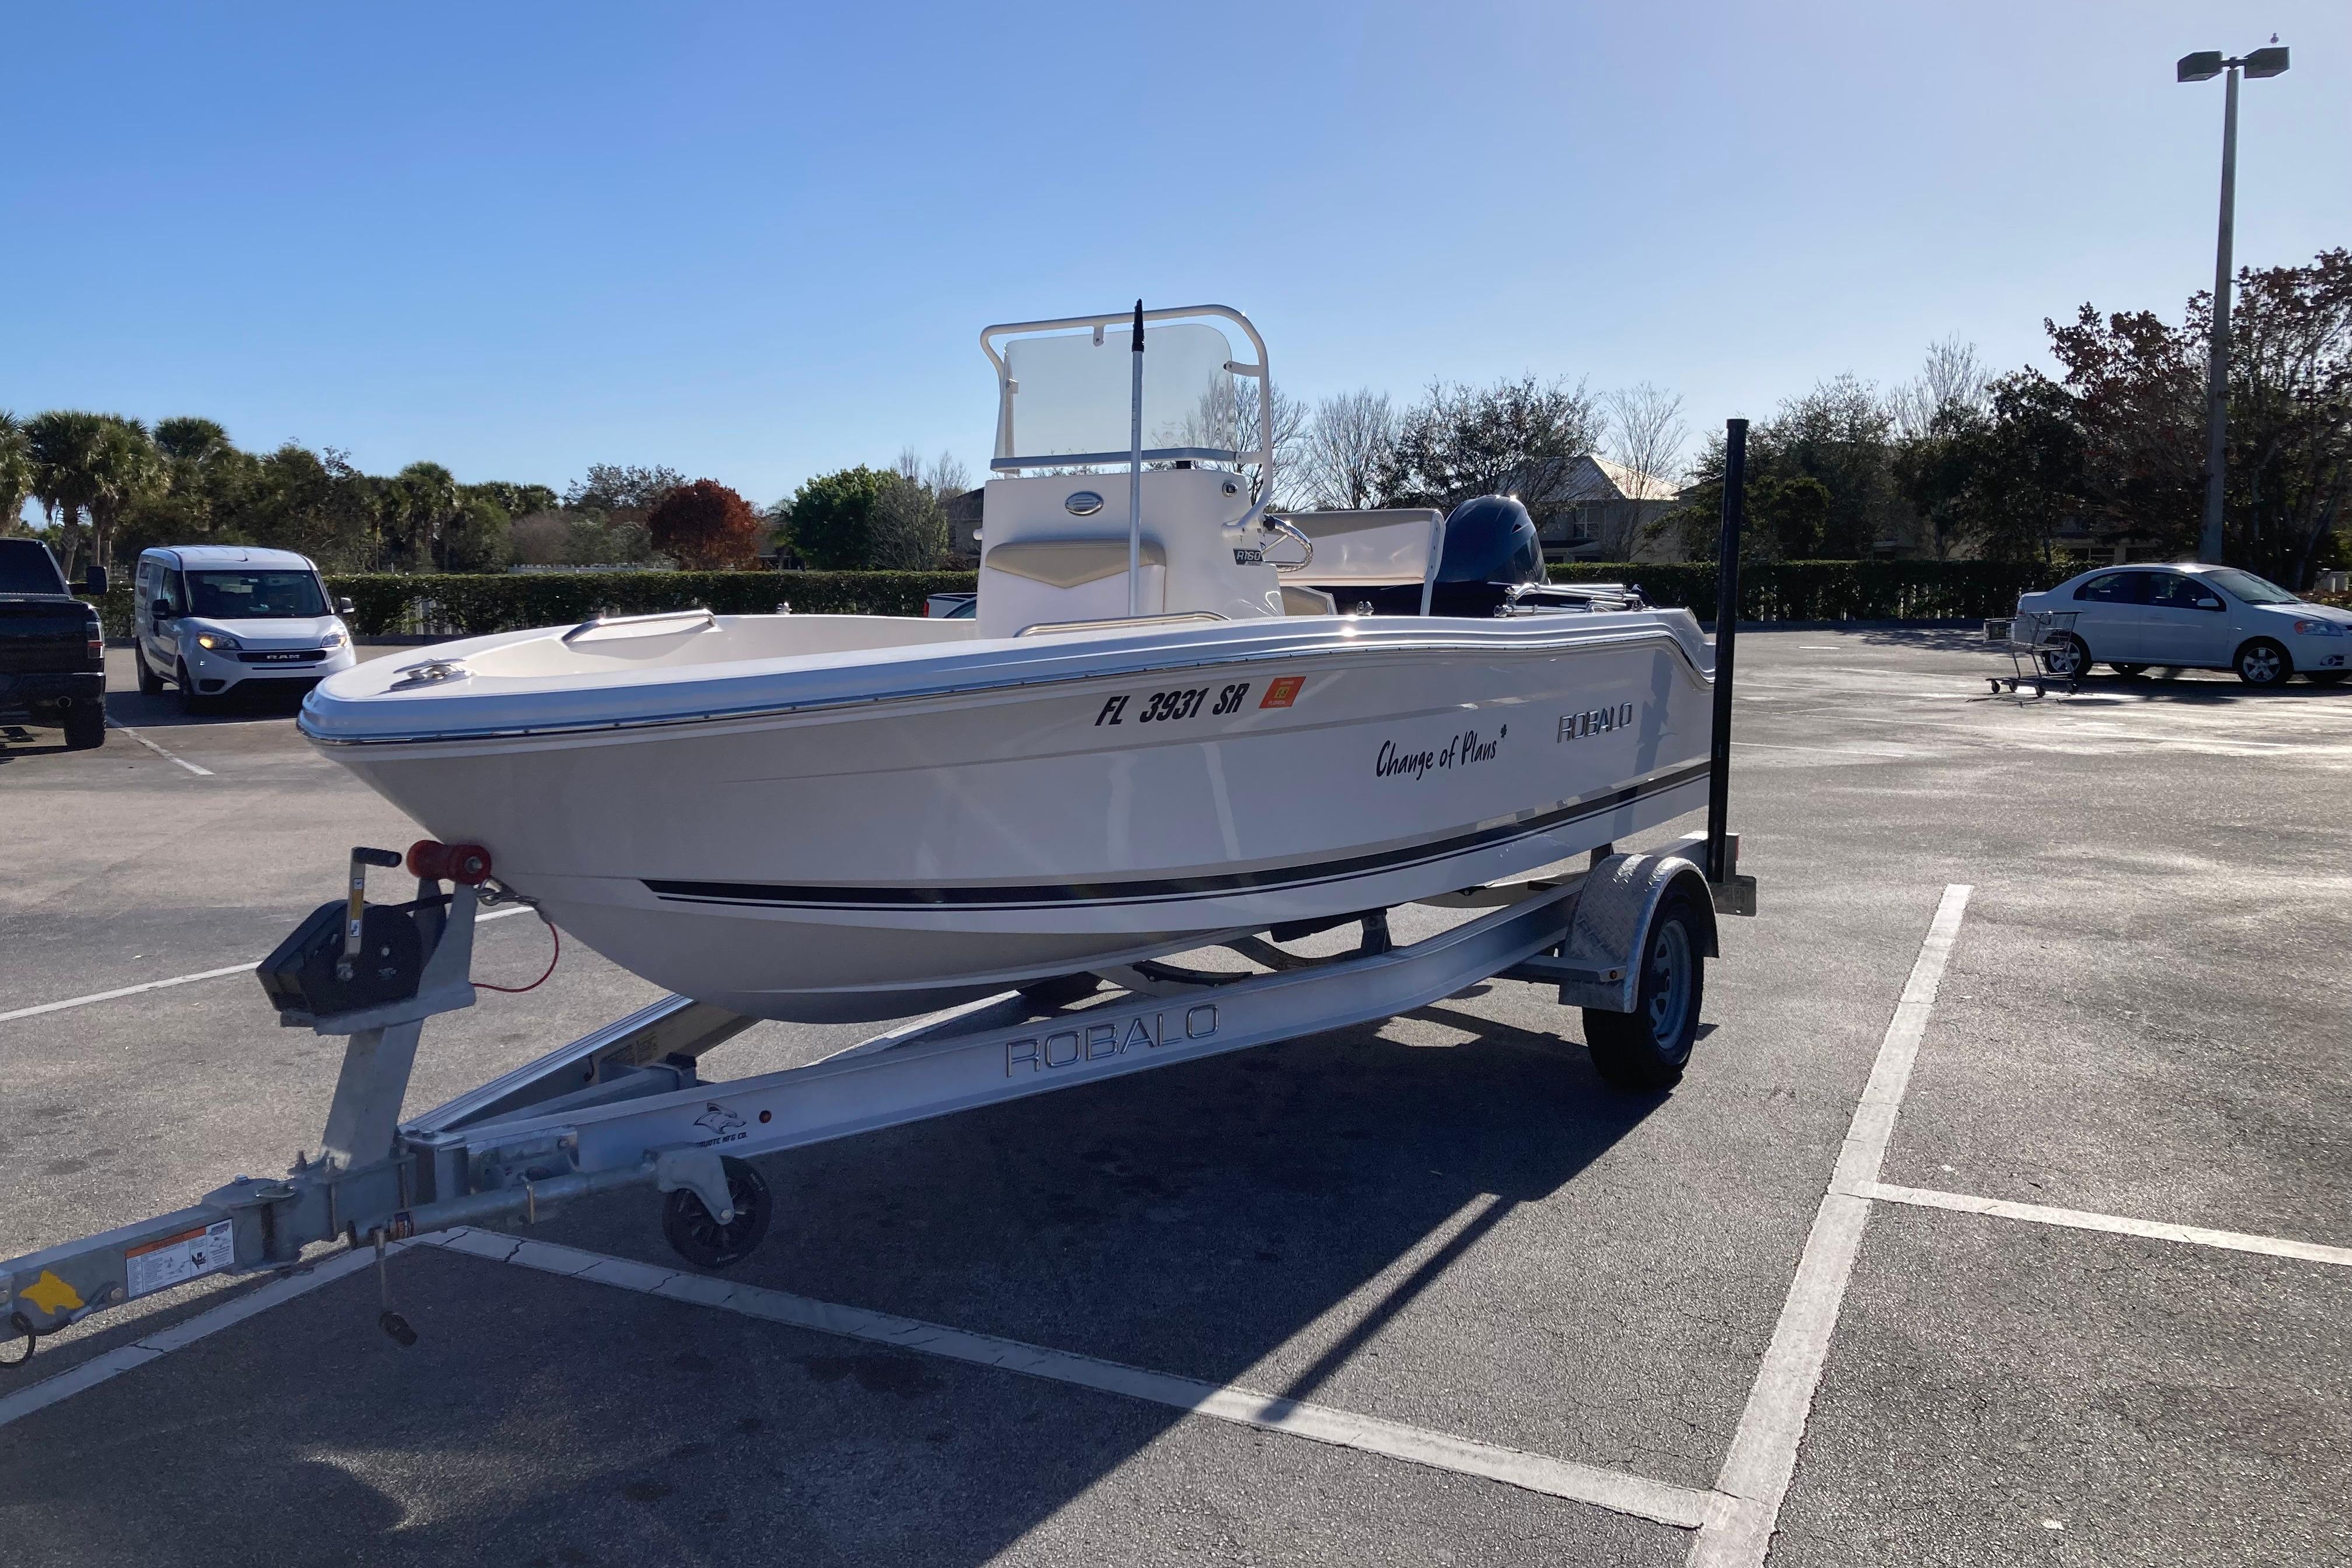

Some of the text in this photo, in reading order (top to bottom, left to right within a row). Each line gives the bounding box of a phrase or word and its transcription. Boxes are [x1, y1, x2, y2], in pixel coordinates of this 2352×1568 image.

[1094, 682, 1250, 726] FL 3931 SR
[1558, 702, 1632, 743] ROBALO
[1376, 730, 1497, 780] Change of Plans
[1006, 1004, 1219, 1077] ROBALO
